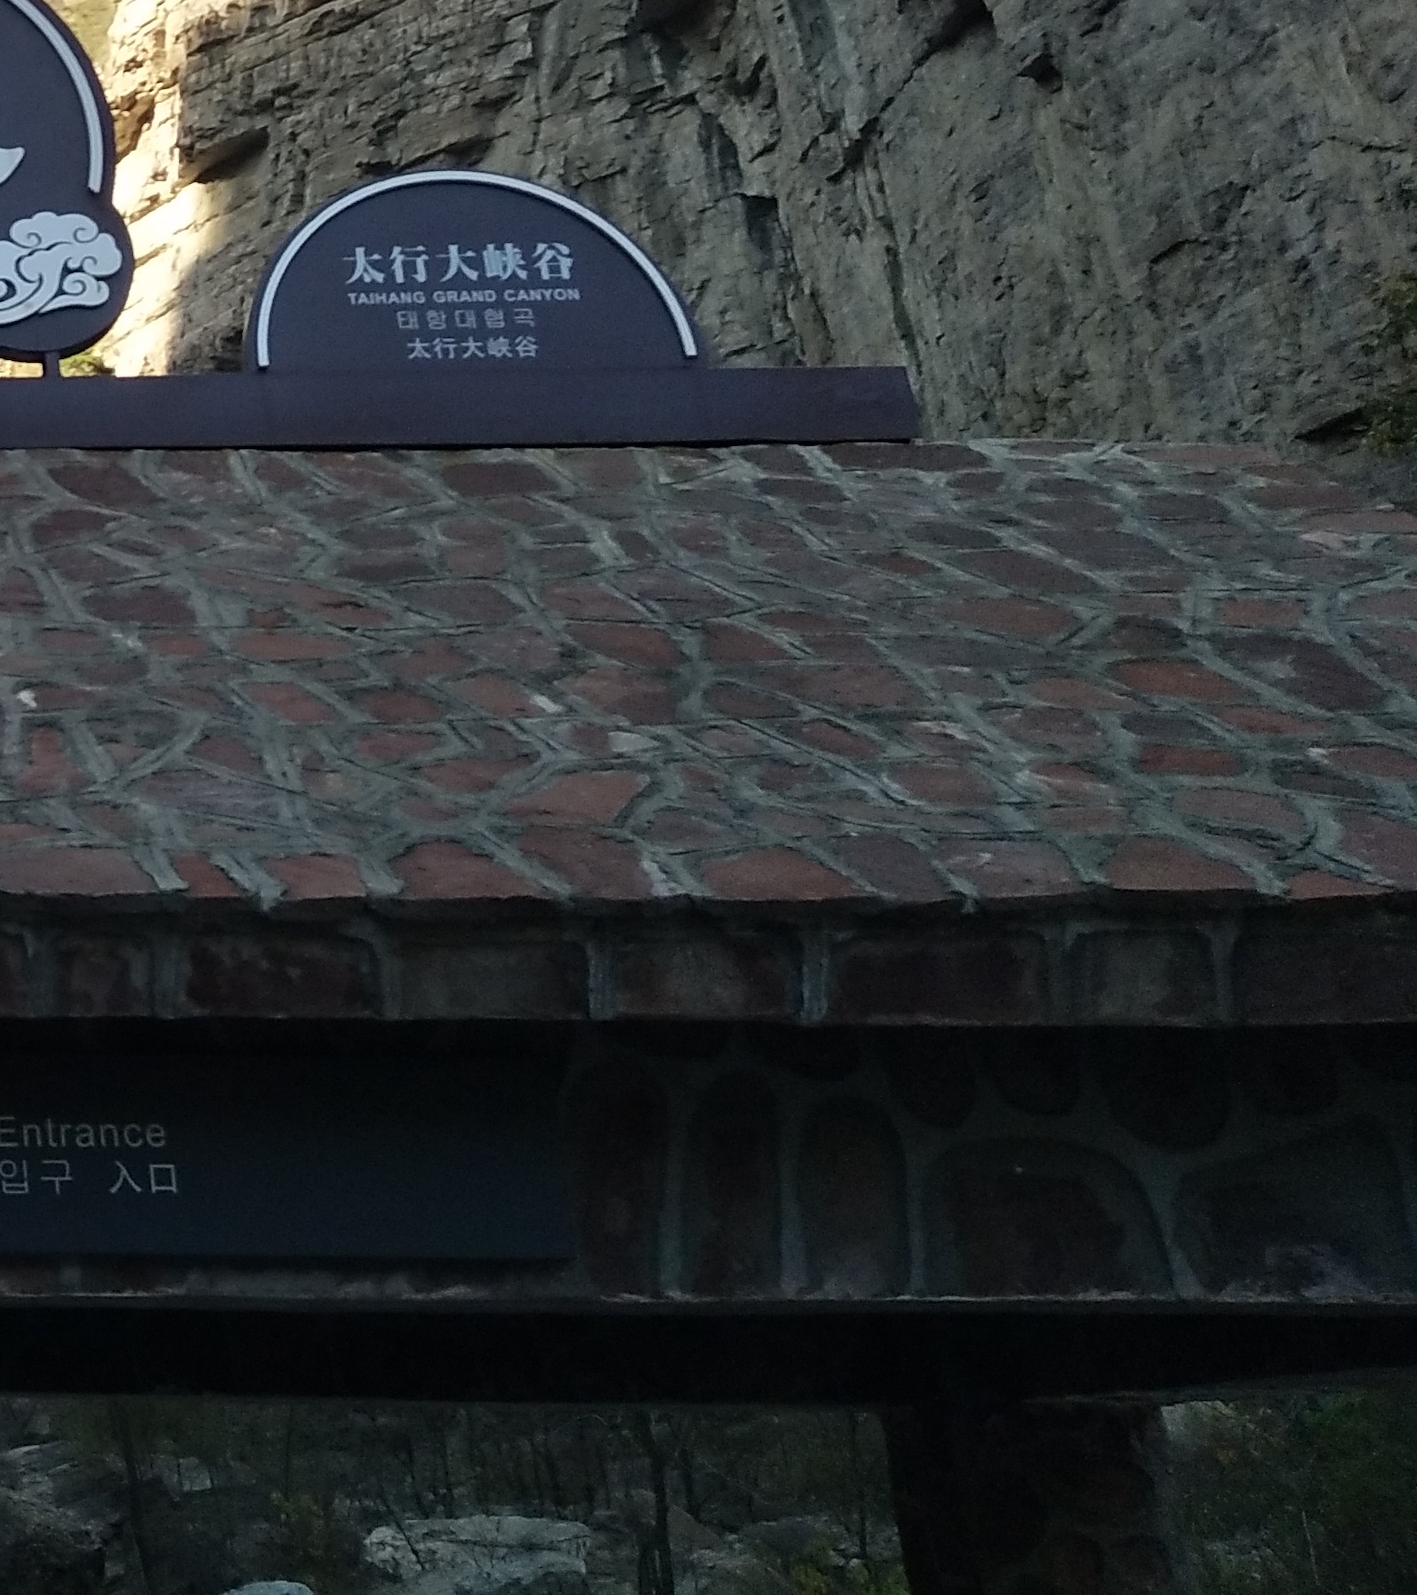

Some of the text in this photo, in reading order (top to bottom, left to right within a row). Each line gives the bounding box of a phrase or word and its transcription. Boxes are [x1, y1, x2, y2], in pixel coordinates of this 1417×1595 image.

[342, 242, 574, 285] 太行大峡谷
[347, 288, 581, 305] TAIHANG GRAND CANYON
[109, 1160, 177, 1194] 入口
